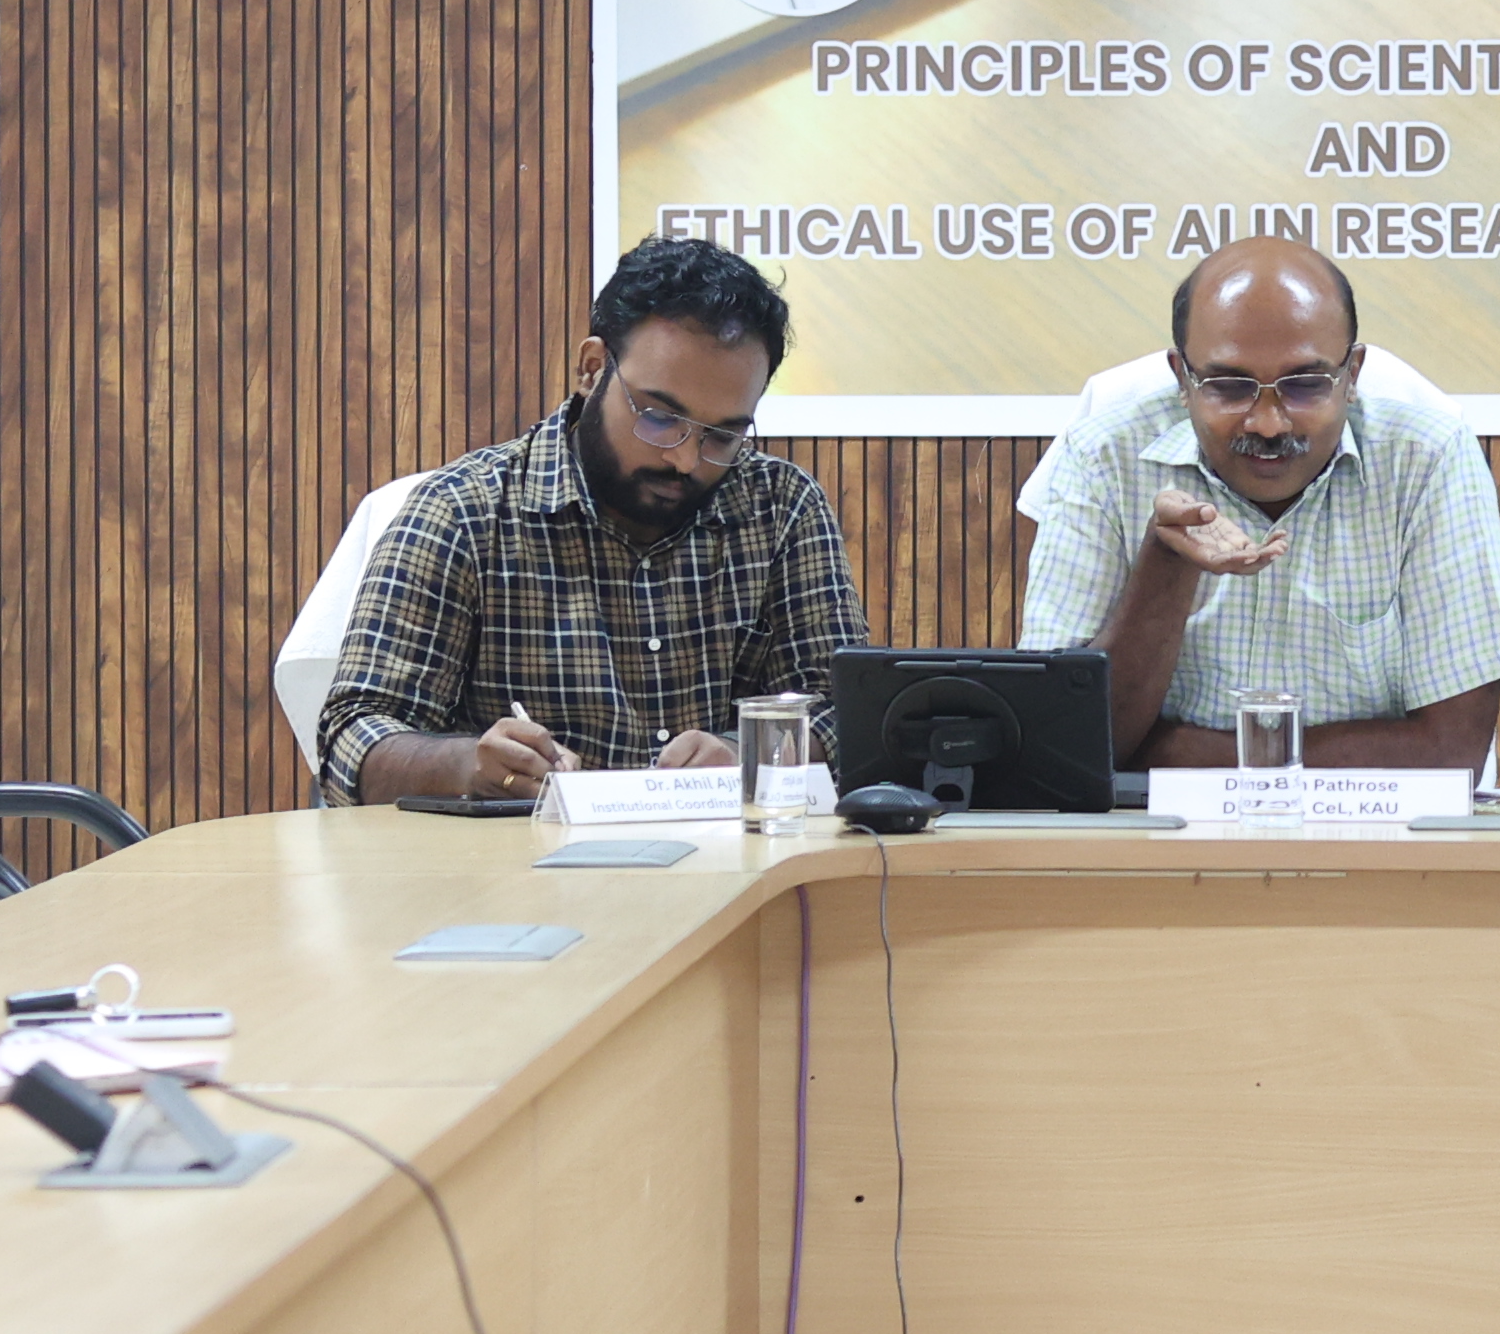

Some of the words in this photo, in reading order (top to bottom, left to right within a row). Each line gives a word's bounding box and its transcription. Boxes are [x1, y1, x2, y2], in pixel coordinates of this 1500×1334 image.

[816, 43, 1168, 92] PRINCIPLES
[1187, 43, 1270, 92] OF
[1309, 126, 1447, 173] AND
[661, 208, 918, 255] ETHICAL
[937, 208, 1051, 255] USE
[1070, 208, 1153, 255] OF
[1171, 208, 1231, 255] AI
[1255, 208, 1313, 249] IN
[645, 778, 670, 792] Dr.
[674, 776, 714, 790] Akhil
[1313, 778, 1399, 792] Pathrose
[591, 799, 673, 813] Institutional
[1312, 802, 1353, 815] CeL,
[1359, 802, 1399, 814] KAU
